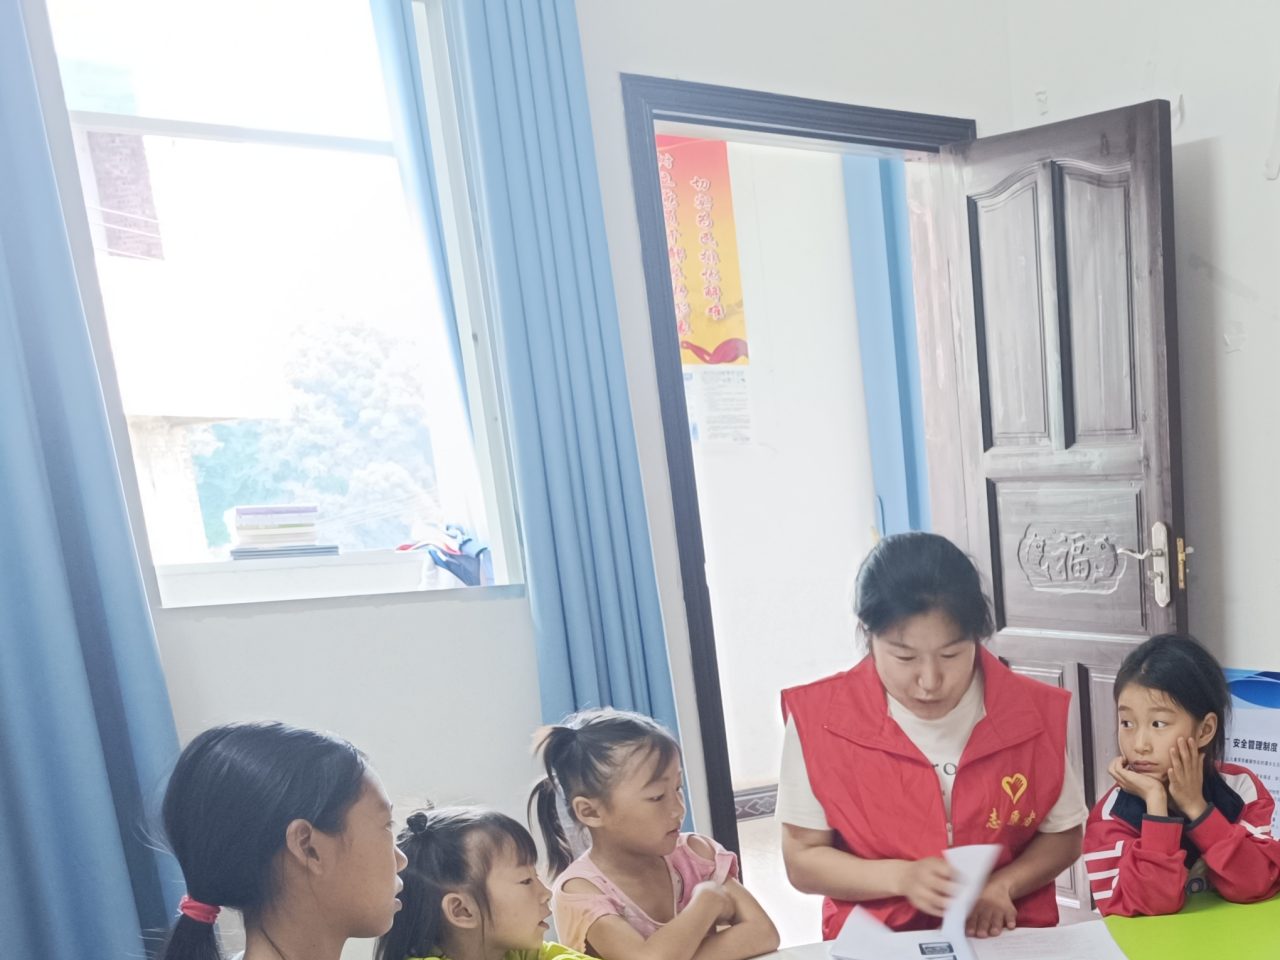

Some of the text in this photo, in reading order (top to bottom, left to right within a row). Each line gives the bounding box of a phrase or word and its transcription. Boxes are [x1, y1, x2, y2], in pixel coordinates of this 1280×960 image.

[1232, 738, 1279, 752] 安全管理制度
